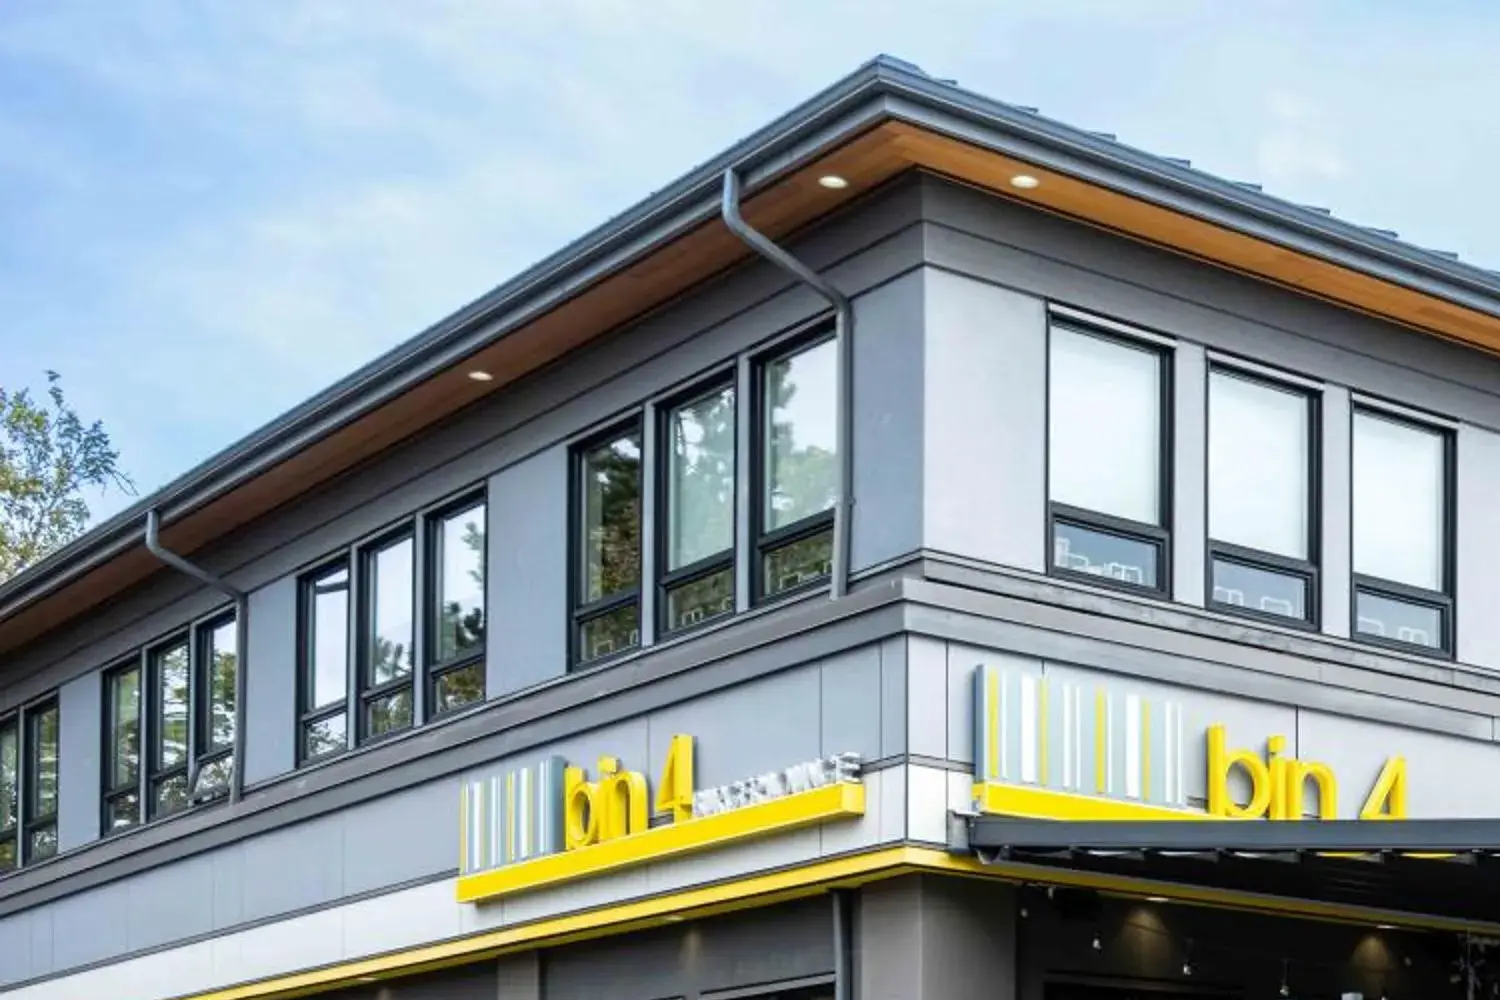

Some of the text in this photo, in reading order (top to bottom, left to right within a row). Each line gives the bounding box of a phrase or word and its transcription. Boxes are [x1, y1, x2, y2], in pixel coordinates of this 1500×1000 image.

[564, 755, 648, 851] bin
[654, 733, 693, 823] 4
[1207, 722, 1408, 820] bin 4
